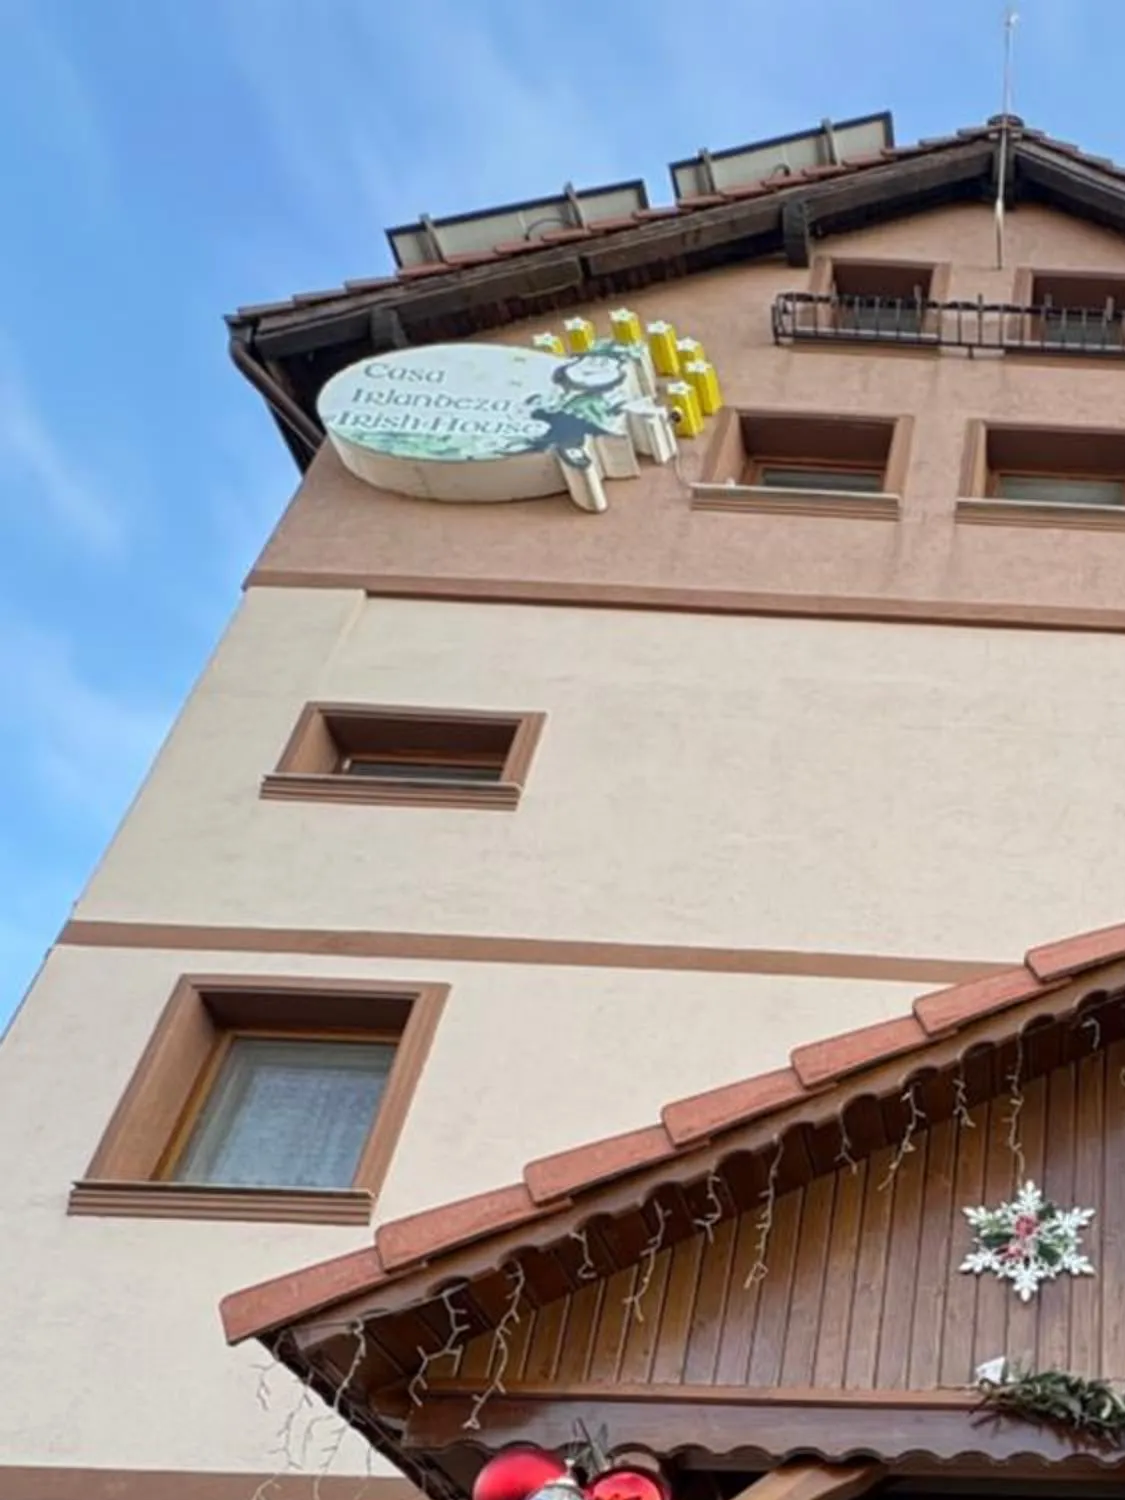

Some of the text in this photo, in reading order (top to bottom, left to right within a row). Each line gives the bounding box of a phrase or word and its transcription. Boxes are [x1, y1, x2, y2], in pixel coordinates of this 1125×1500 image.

[364, 362, 445, 384] Casa
[336, 409, 544, 436] Irish House
